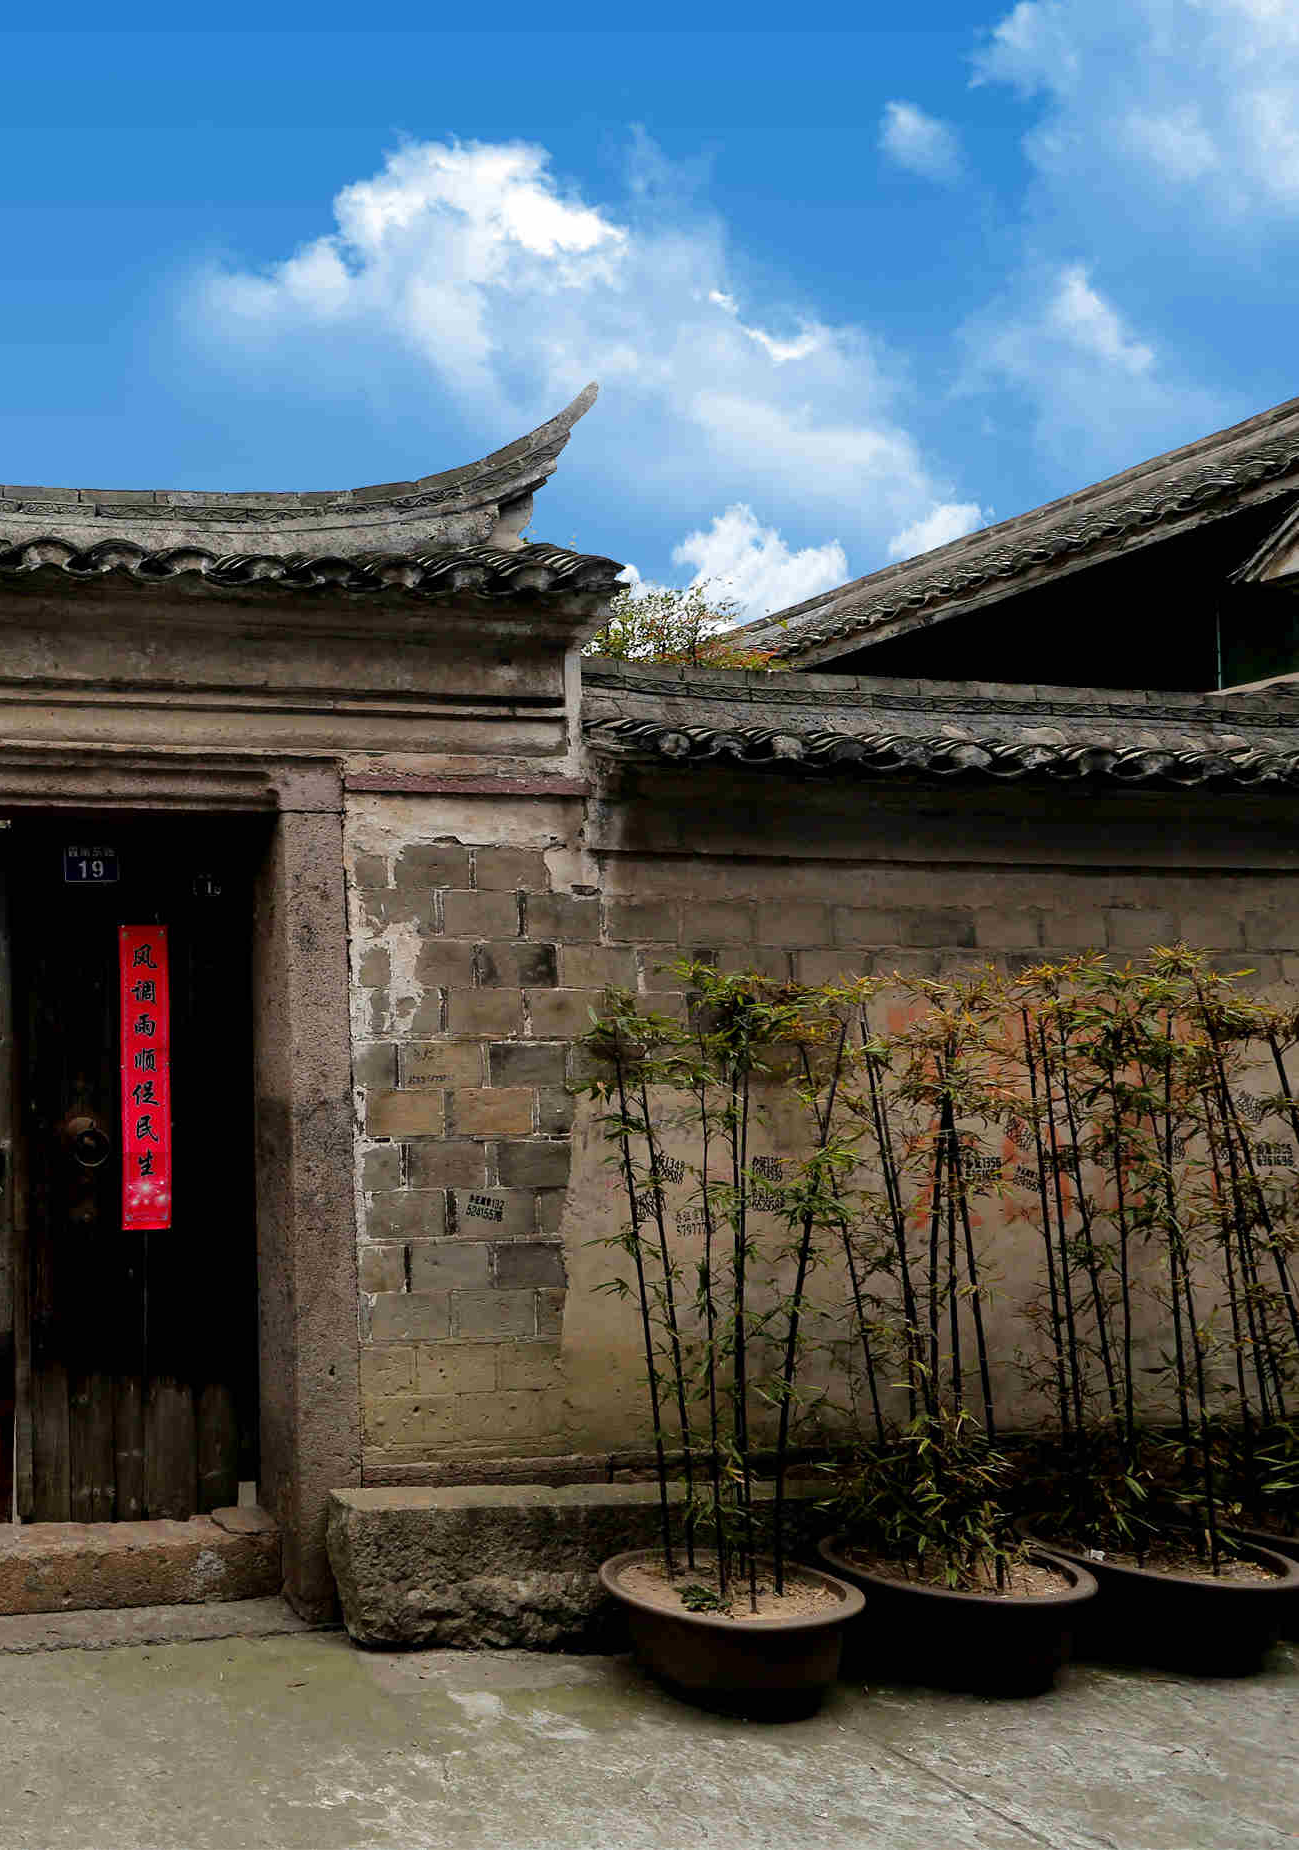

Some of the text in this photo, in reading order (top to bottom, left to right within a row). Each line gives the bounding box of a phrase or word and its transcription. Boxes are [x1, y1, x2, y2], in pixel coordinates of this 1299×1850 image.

[78, 860, 104, 879] 19
[131, 943, 159, 1177] 风调雨顺促民生
